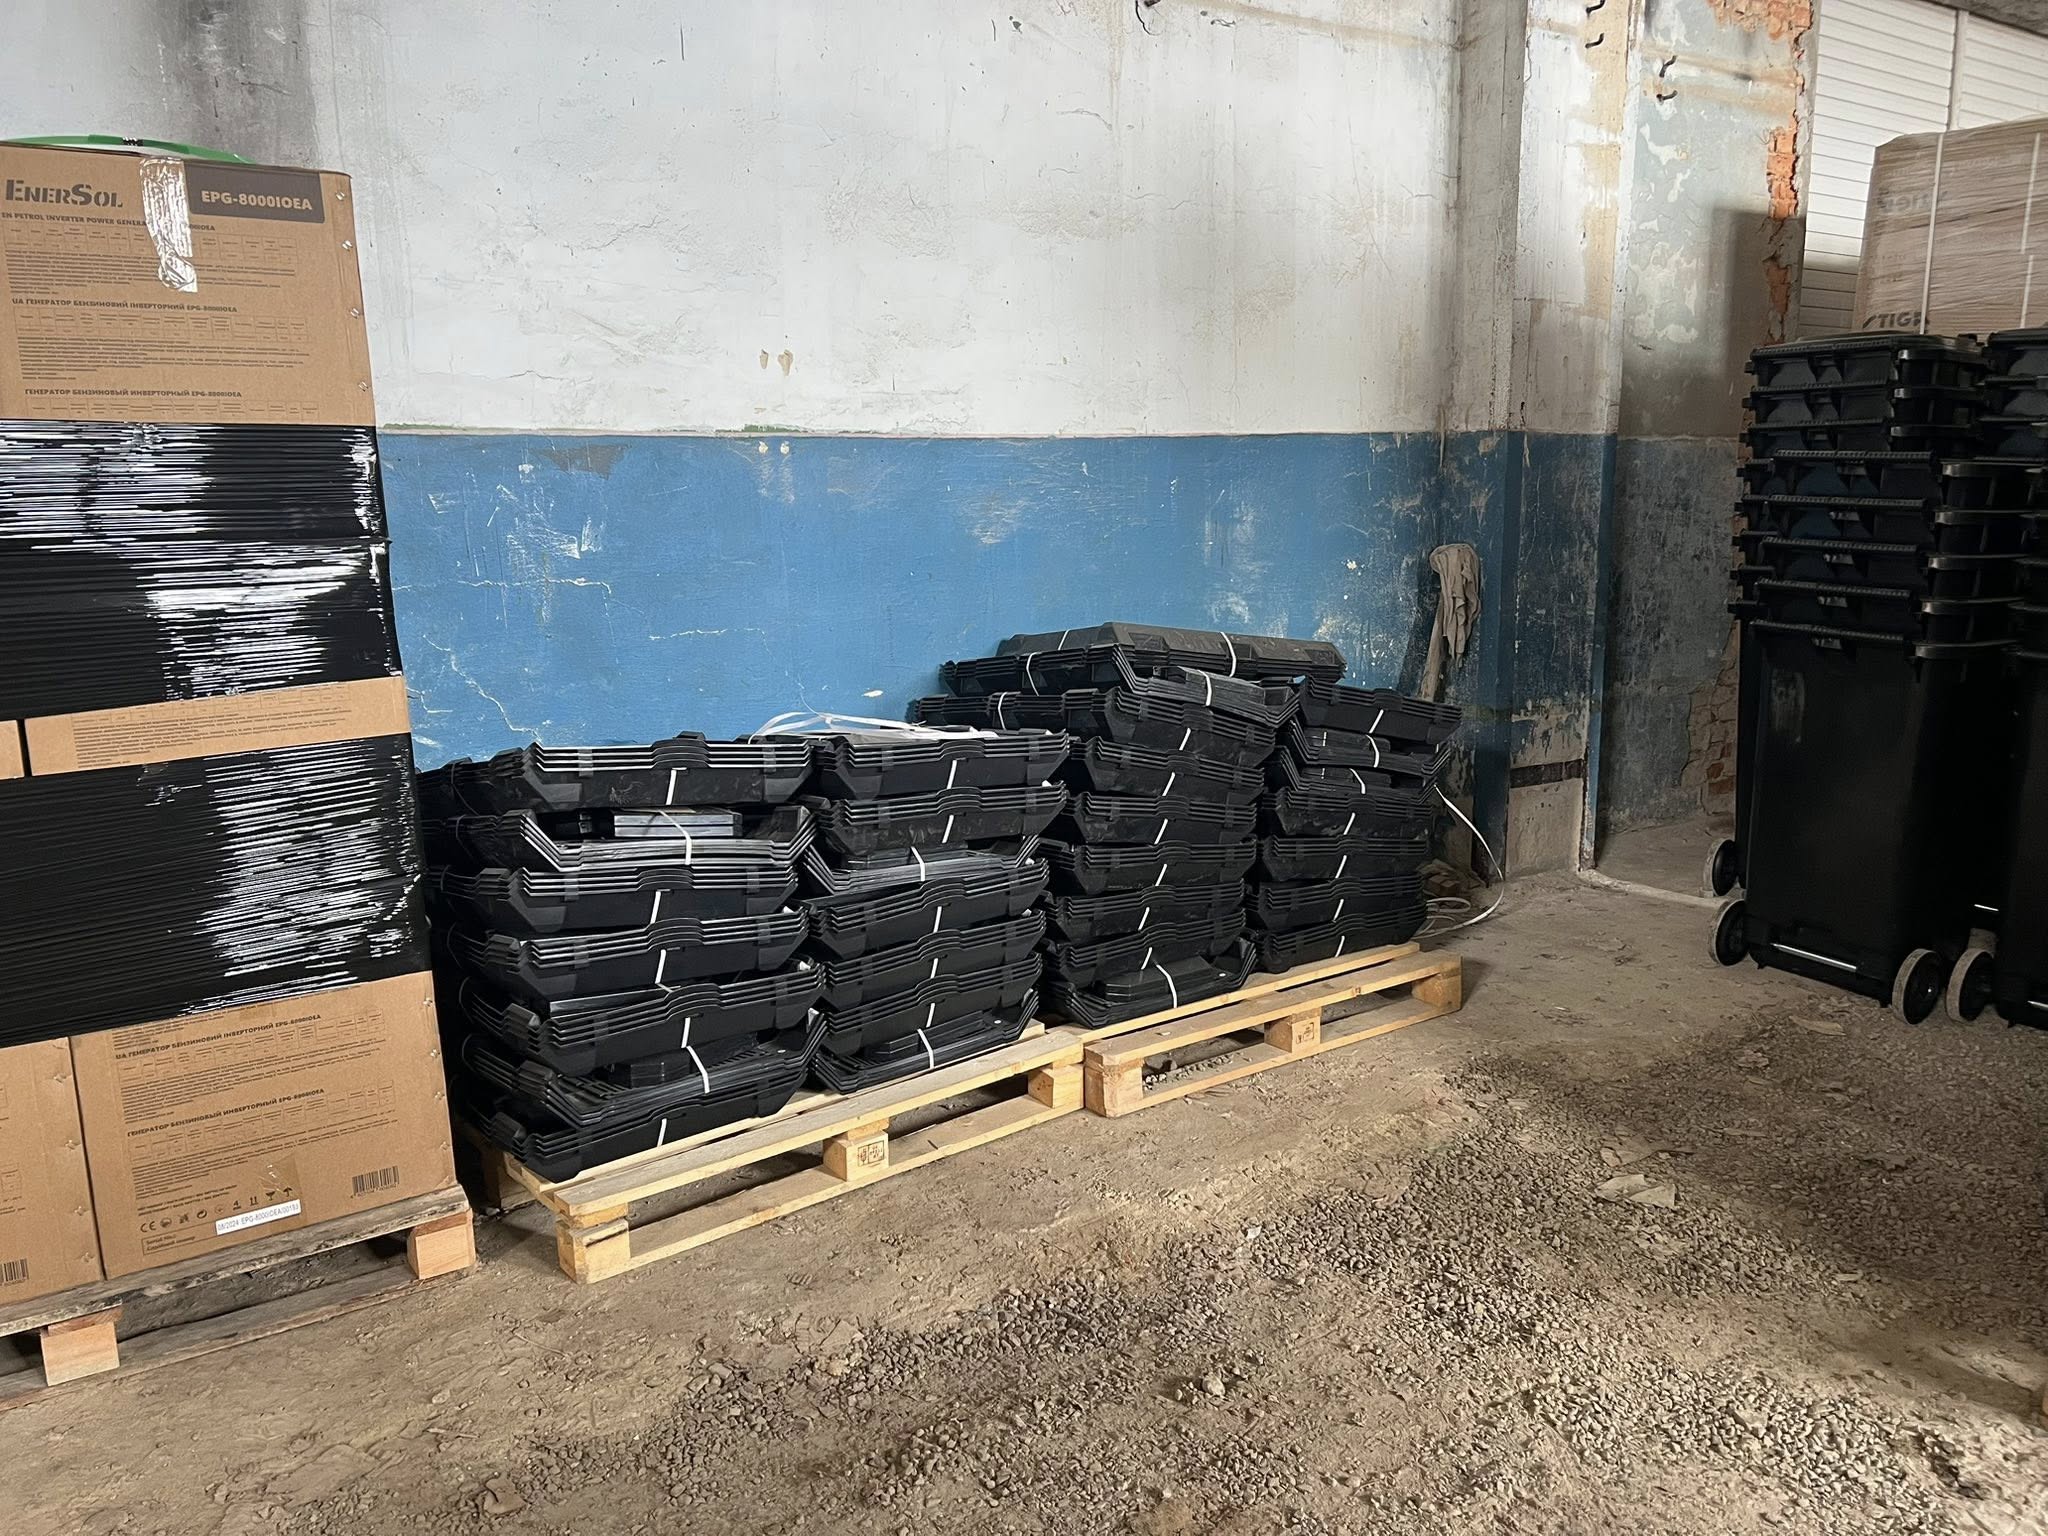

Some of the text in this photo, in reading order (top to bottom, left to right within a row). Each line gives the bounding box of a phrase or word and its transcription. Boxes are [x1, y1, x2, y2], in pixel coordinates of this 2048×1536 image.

[201, 190, 312, 210] EPG-8000IOEA
[46, 214, 84, 223] INVERTER
[86, 217, 114, 225] POWER
[73, 300, 128, 309] БЕНЗИНОВИЙ
[130, 302, 185, 311] ІНВЕРТОРНИЙ
[25, 388, 70, 396] ГЕНЕРАТОР
[72, 388, 128, 396] БЕНЗИНОВЫЙ
[130, 389, 190, 397] ИНВЕРТОРНЫЙ
[128, 1044, 170, 1058] ГЕНЕРАТОР
[172, 1033, 222, 1049] БЕНЗИНОВИЙ
[223, 1022, 274, 1039] ІНВЕРТОРНИЙ
[127, 1123, 169, 1137] ГЕНЕРАТОР
[170, 1111, 222, 1128] БЕНЗИНОВЫЙ
[223, 1098, 277, 1116] ИНВЕРТОРНЫЙ
